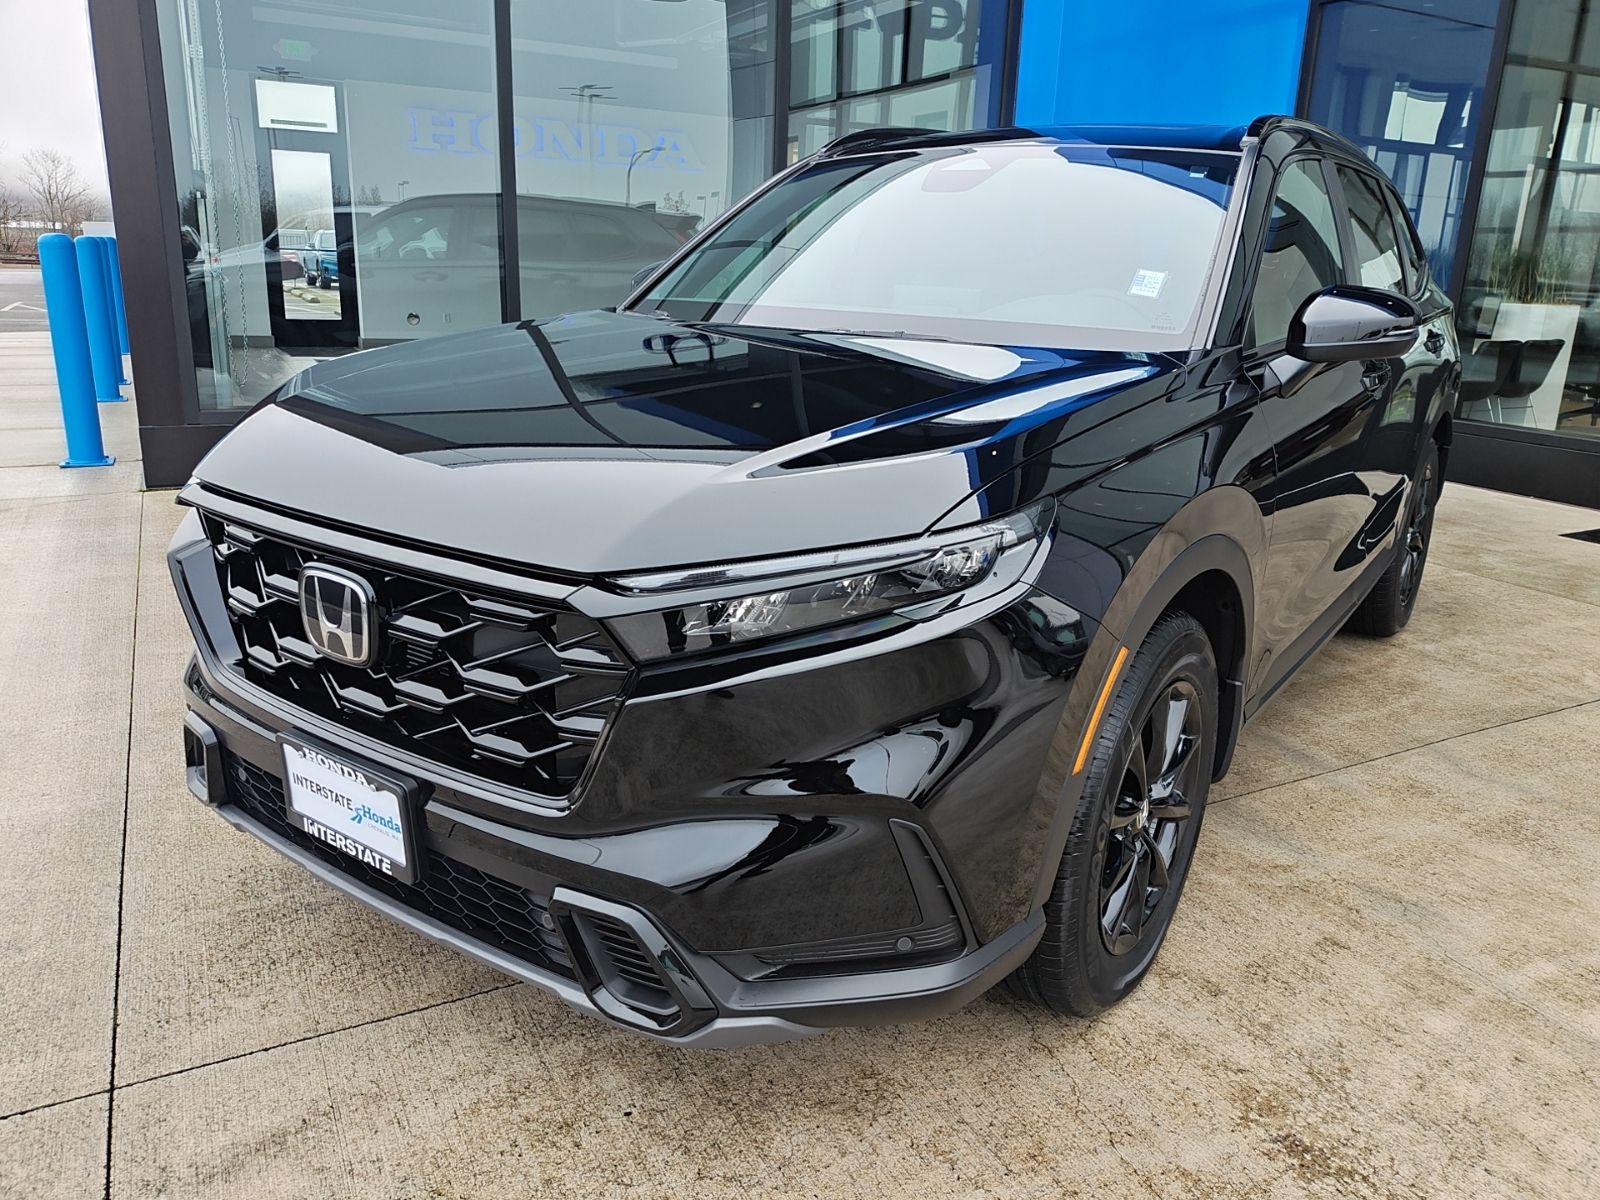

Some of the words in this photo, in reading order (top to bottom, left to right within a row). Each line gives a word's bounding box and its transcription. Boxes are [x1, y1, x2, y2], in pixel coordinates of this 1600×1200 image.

[407, 107, 704, 172] HONDA
[303, 747, 369, 787] HONDA
[292, 772, 354, 811] INTERSTATE
[361, 804, 401, 833] Honda
[303, 817, 393, 875] INTERSTATE
